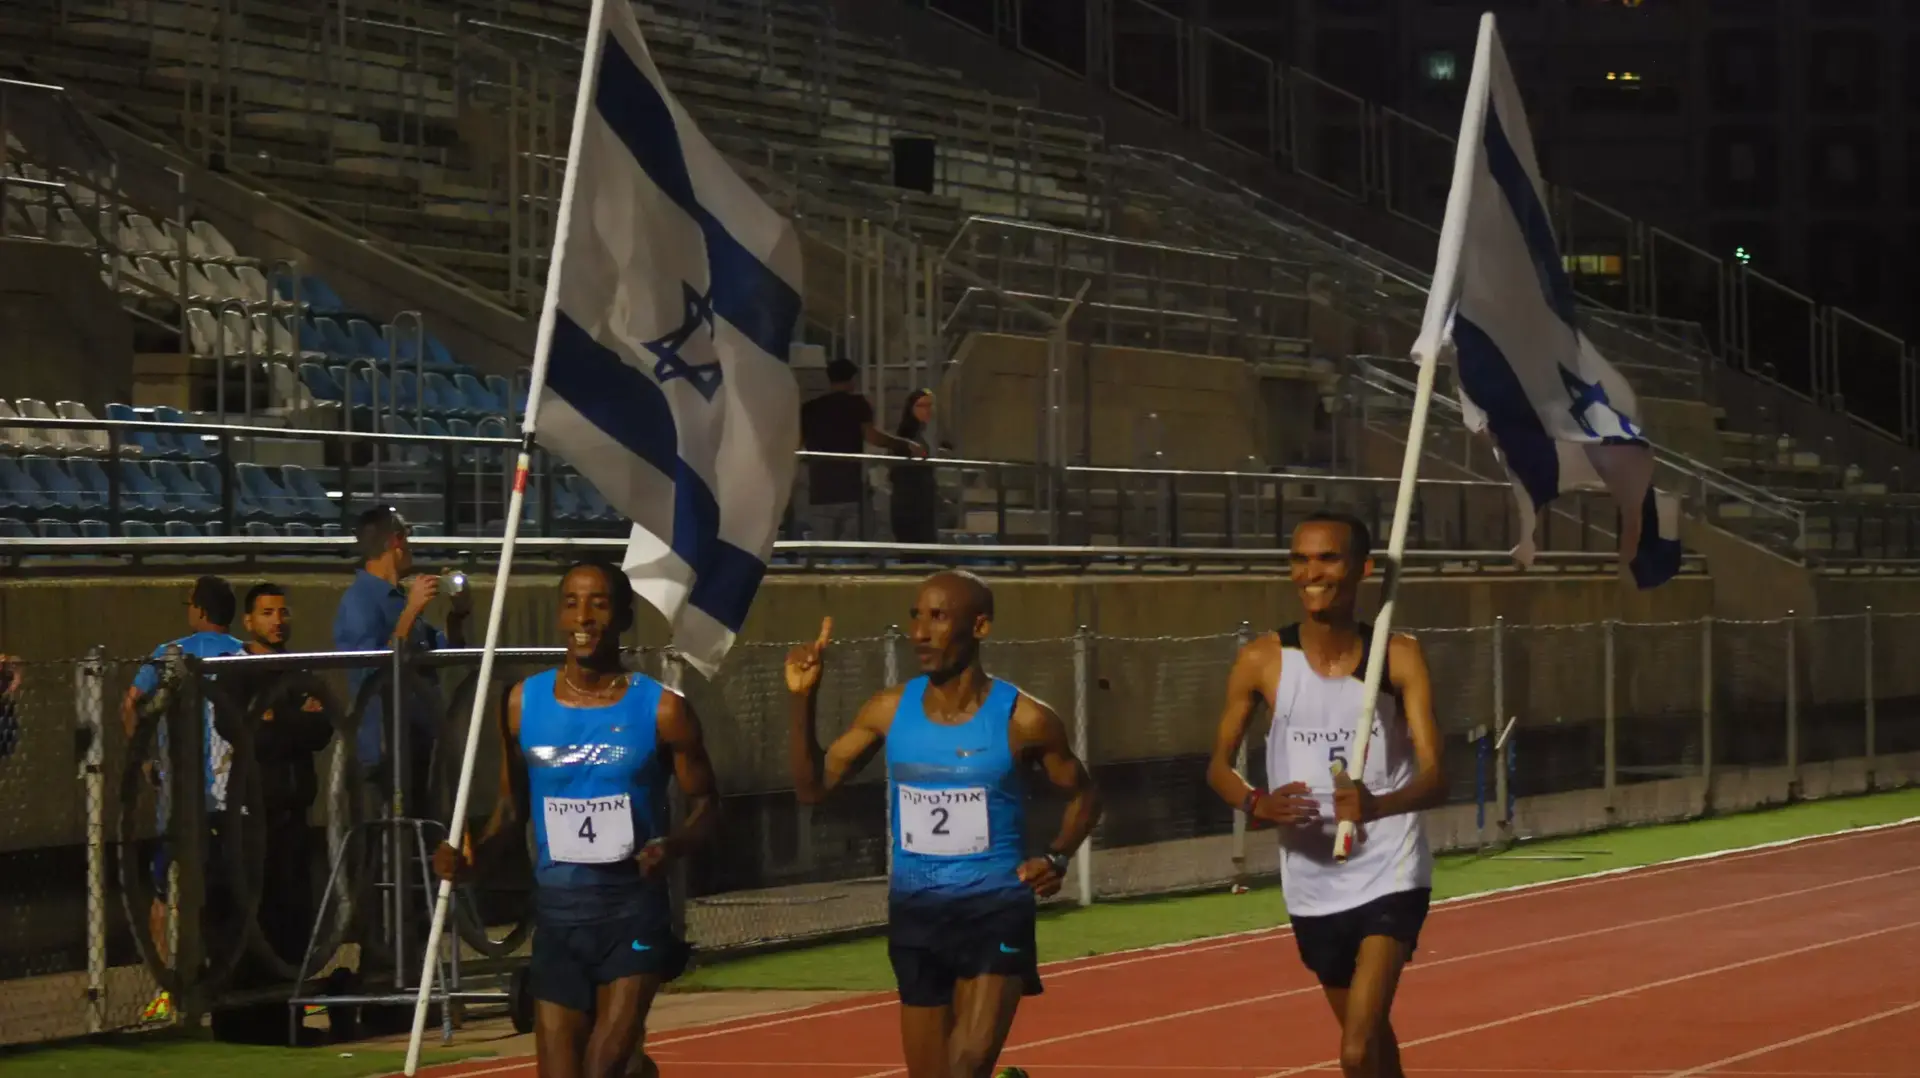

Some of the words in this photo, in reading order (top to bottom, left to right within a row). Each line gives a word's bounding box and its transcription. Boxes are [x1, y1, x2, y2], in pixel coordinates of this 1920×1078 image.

[1329, 746, 1348, 775] 5
[548, 799, 625, 815] אתלטיקה
[903, 790, 982, 805] אתלטיקה
[578, 816, 597, 843] 4
[930, 807, 950, 835] 2
